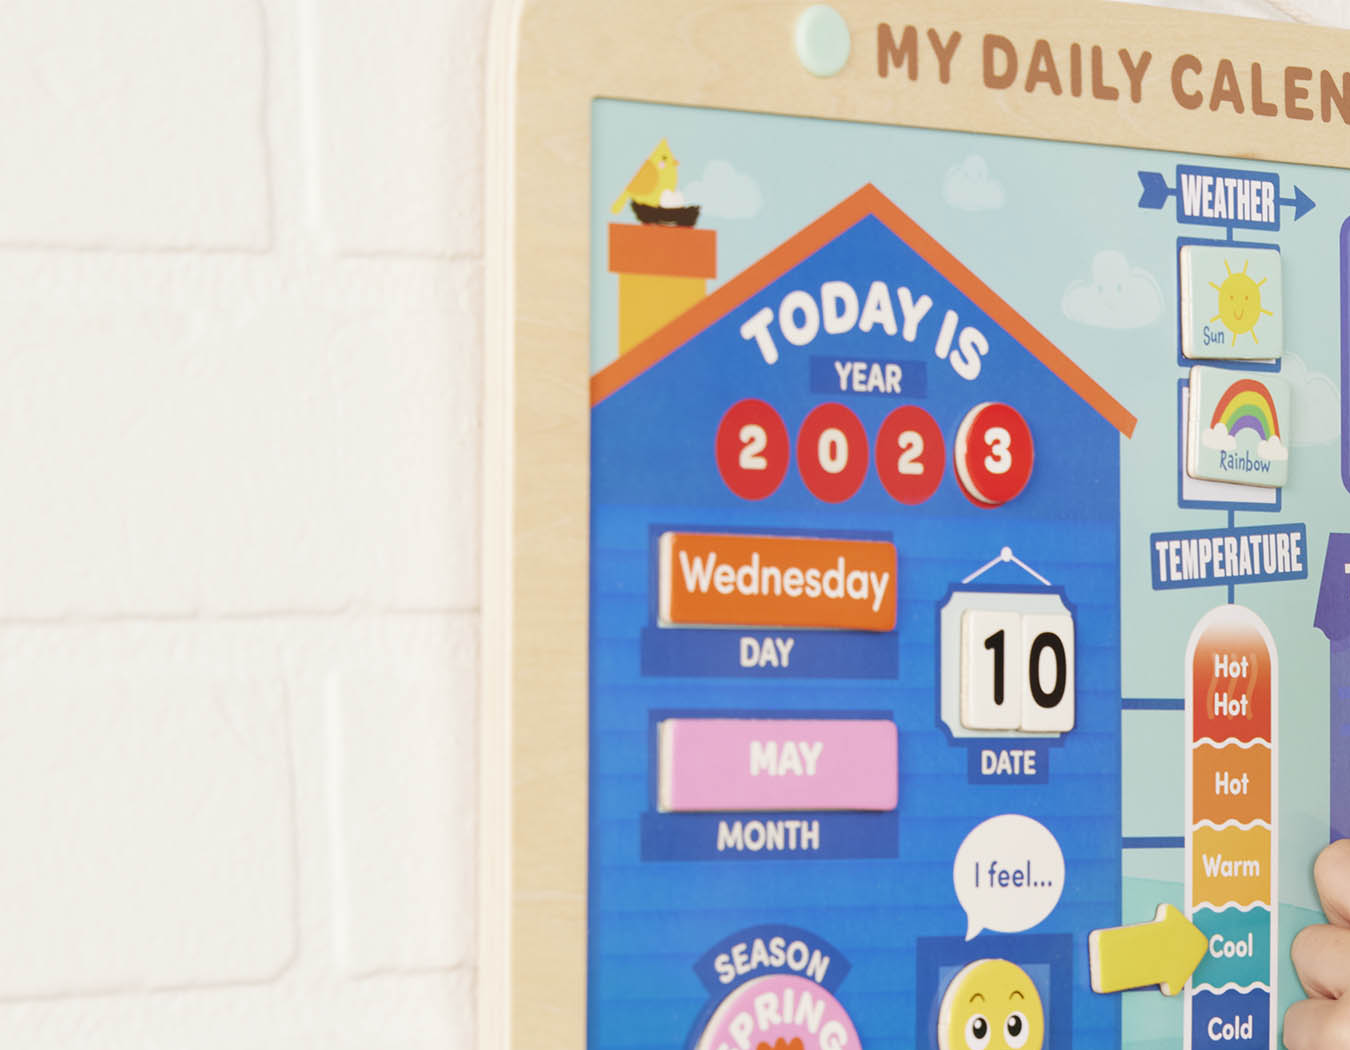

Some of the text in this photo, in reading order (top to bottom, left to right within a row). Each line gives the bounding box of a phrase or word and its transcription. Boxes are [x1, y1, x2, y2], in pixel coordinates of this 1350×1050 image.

[877, 22, 962, 84] MY
[982, 33, 1152, 104] DAILY
[1181, 173, 1275, 223] WEATHER
[740, 281, 989, 381] TODAY IS
[1203, 326, 1225, 345] Sun
[834, 361, 902, 394] YEAR
[1220, 450, 1271, 472] Rainbow
[1156, 531, 1303, 582] TEMPERATURE
[679, 550, 889, 612] Wednesday
[740, 637, 794, 668] DAY
[1214, 653, 1249, 678] Hot
[984, 629, 1067, 708] 10
[1214, 692, 1249, 716] Hot
[749, 742, 822, 776] MAY
[981, 750, 1036, 775] DATE
[1215, 771, 1250, 795] Hot
[716, 820, 820, 851] MONTH
[974, 861, 1053, 888] I feel...
[1202, 854, 1260, 877] Warm
[714, 937, 831, 983] SEASON
[1209, 933, 1253, 958] Cool
[1207, 1014, 1253, 1041] Cold
